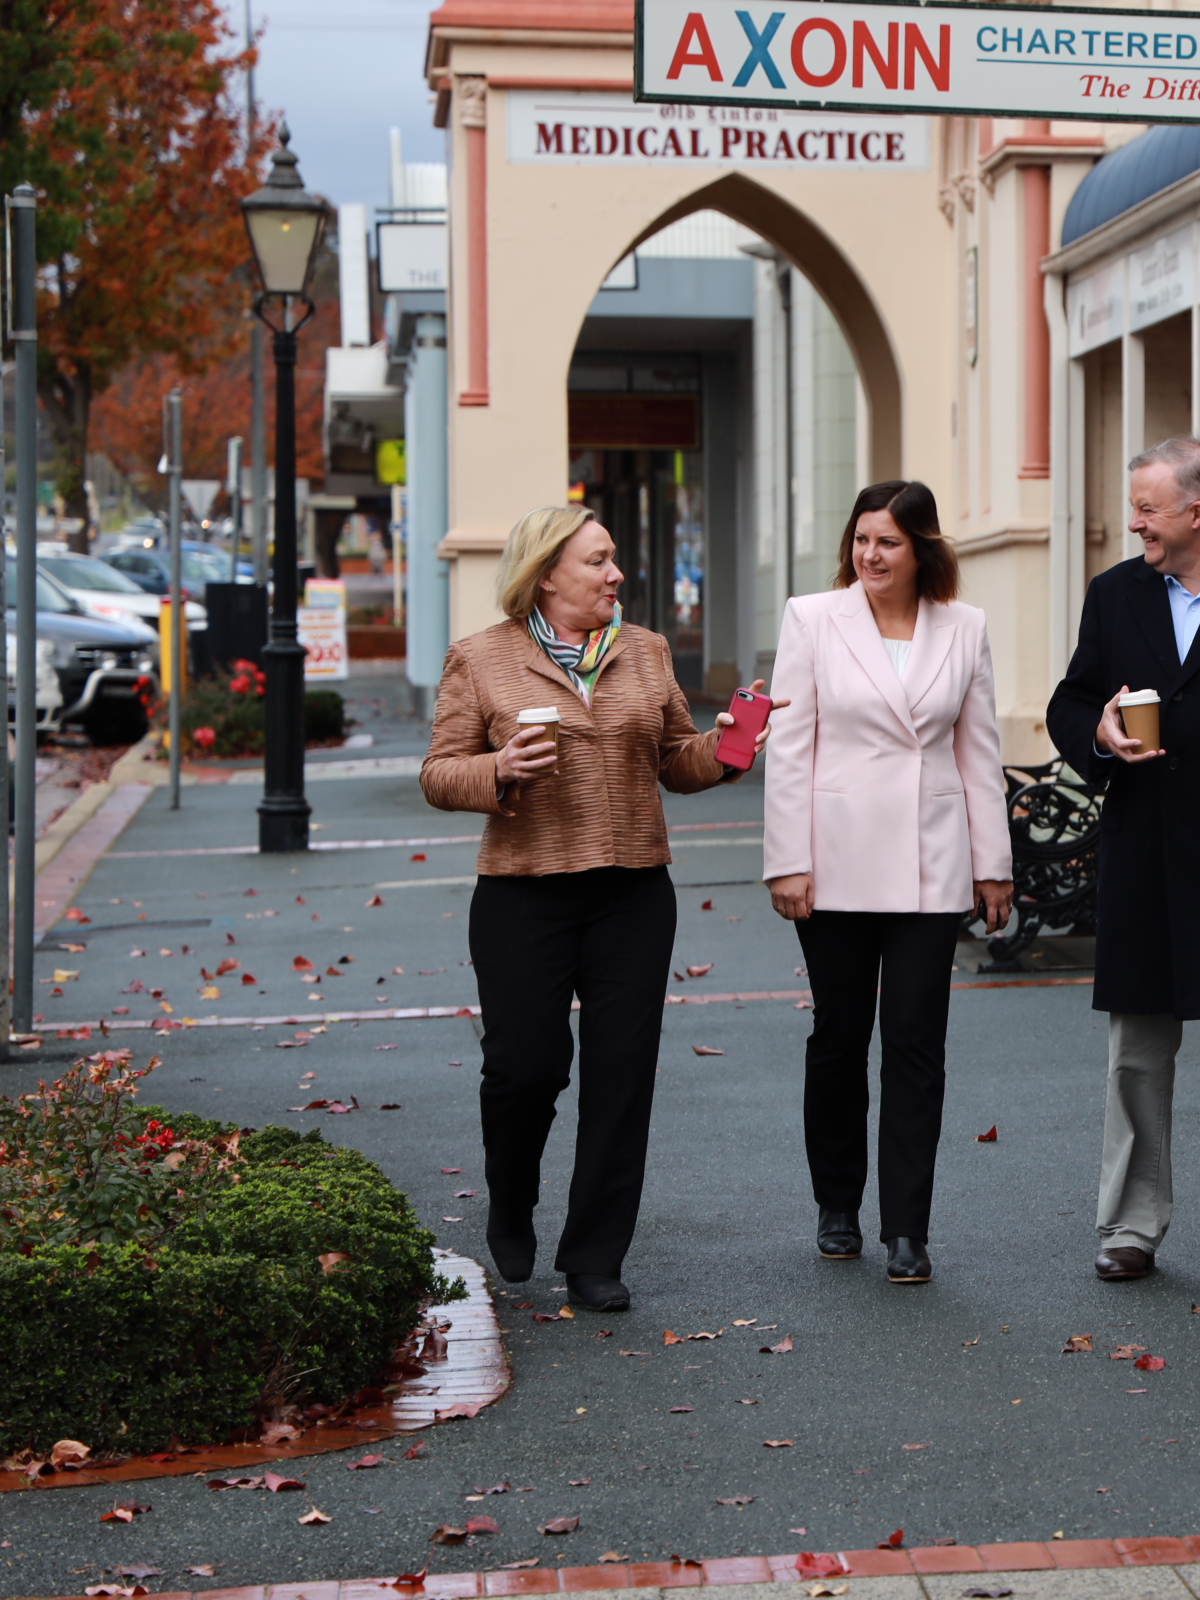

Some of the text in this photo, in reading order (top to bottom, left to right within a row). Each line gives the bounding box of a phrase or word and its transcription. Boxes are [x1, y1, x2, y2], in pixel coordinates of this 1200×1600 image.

[666, 10, 951, 92] AXONN
[976, 26, 1198, 60] CHARTERED
[1079, 75, 1131, 98] The
[534, 122, 905, 161] MEDICAL PRACTICE
